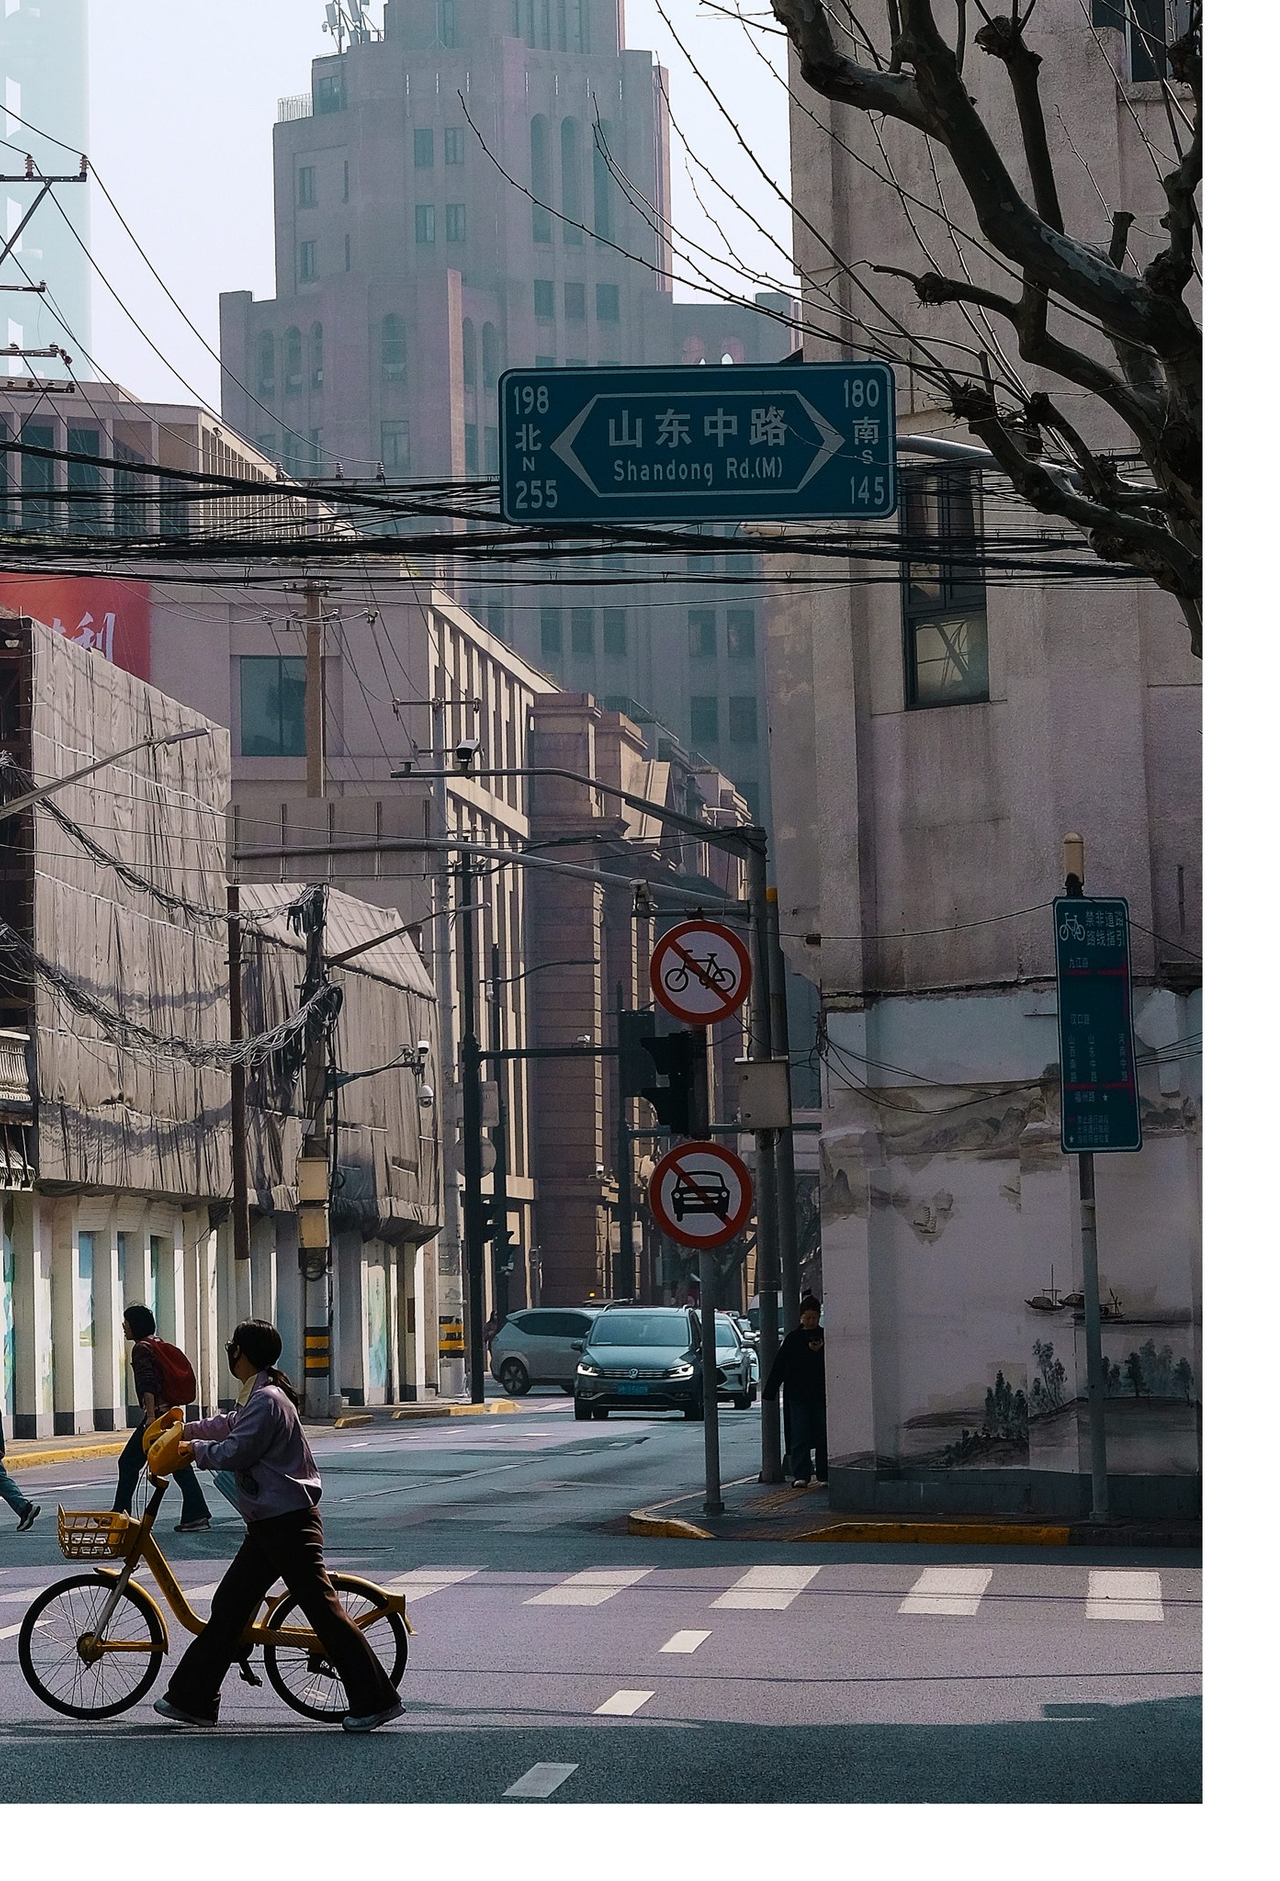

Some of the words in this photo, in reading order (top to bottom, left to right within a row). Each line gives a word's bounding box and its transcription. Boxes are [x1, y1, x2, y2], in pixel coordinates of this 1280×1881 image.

[514, 385, 549, 415] 198
[843, 378, 880, 408] 180
[515, 423, 542, 452] 北
[608, 406, 788, 449] 山东中路
[852, 416, 880, 445] 南
[522, 456, 536, 472] N
[613, 459, 713, 487] Shandong
[726, 456, 783, 480] Rd.(M)
[862, 449, 874, 465] S
[515, 479, 558, 509] 255
[850, 475, 885, 505] 145
[1086, 930, 1126, 947] 路线指引
